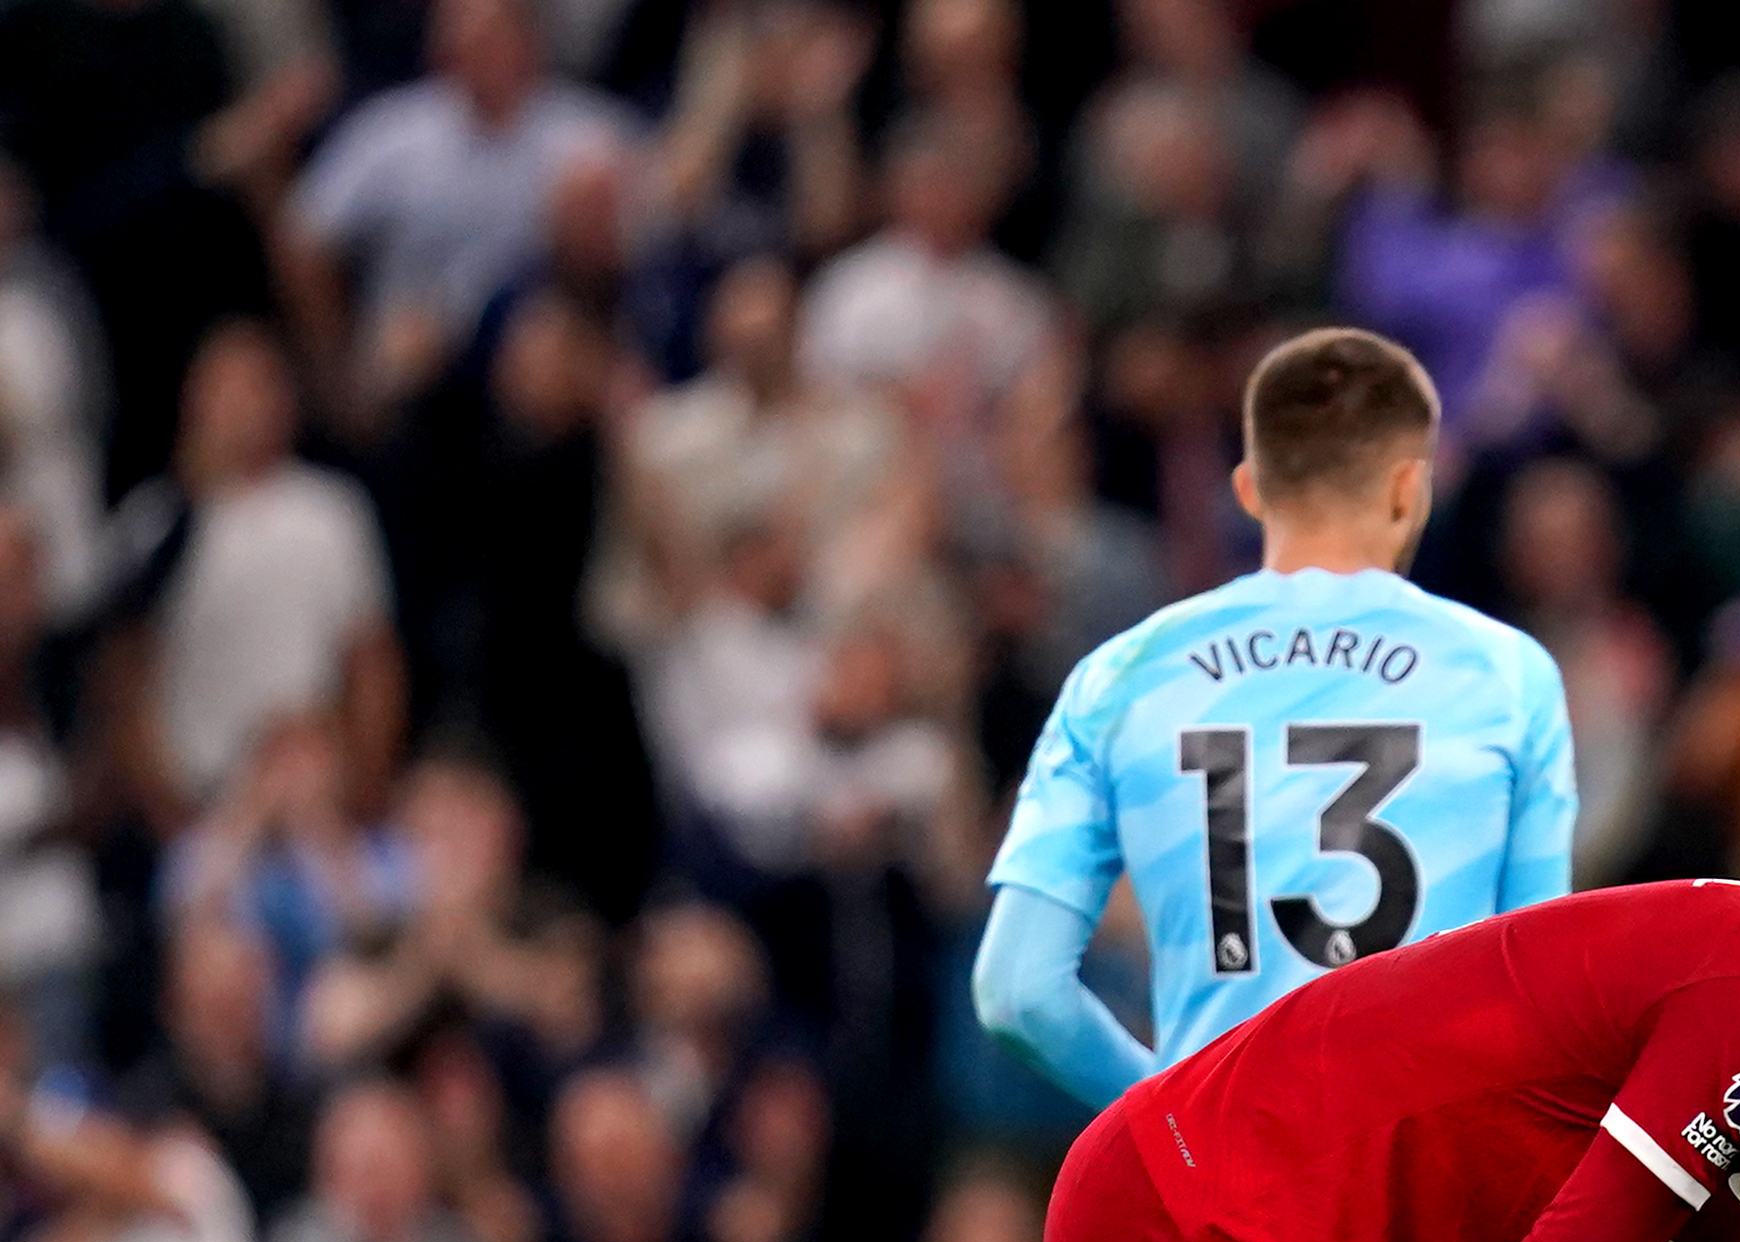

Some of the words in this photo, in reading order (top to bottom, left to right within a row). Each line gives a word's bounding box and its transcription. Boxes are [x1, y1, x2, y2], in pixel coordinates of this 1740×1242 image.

[1188, 627, 1419, 683] VICARIO
[1178, 721, 1424, 977] 13
[1691, 1111, 1717, 1139] No
